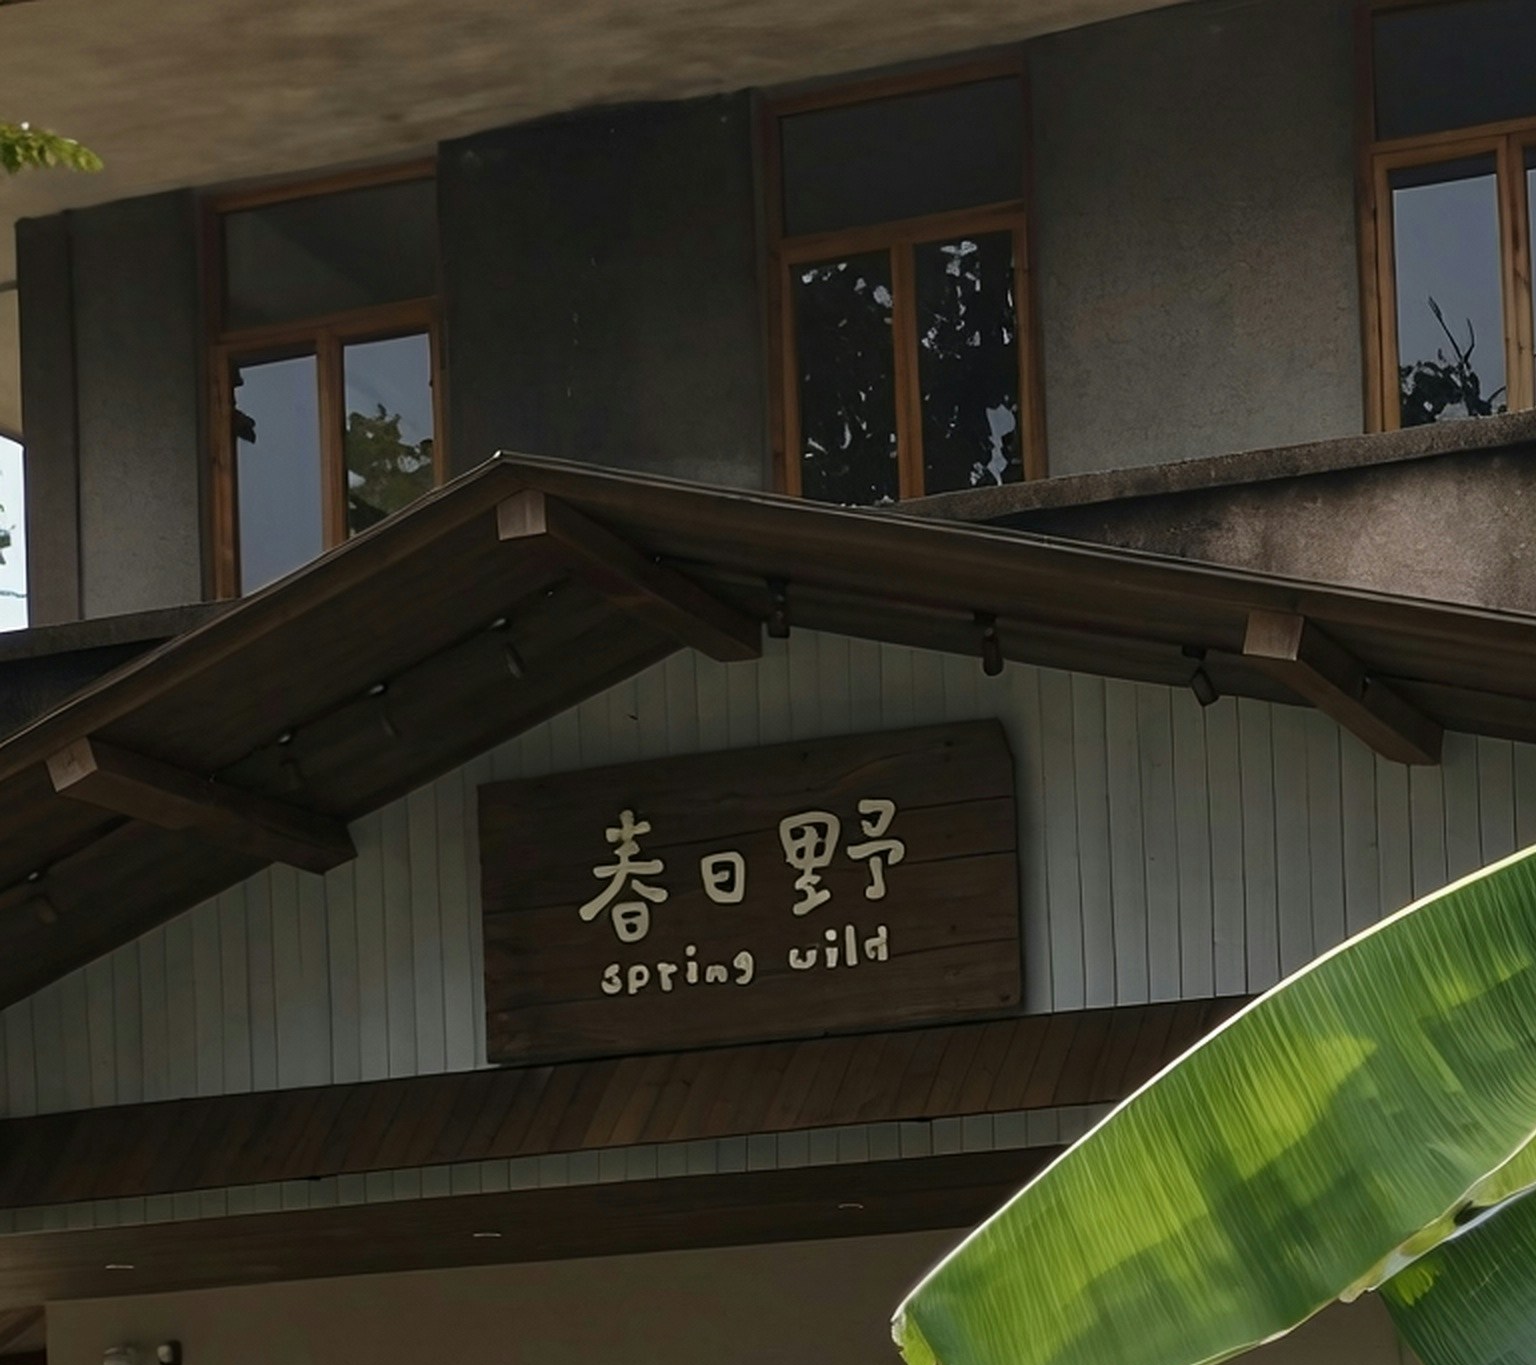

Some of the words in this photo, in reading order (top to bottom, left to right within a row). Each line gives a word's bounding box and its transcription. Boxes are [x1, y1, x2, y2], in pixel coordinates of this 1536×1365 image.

[579, 799, 905, 943] 春日野
[601, 945, 754, 994] spring
[789, 925, 888, 969] wild
